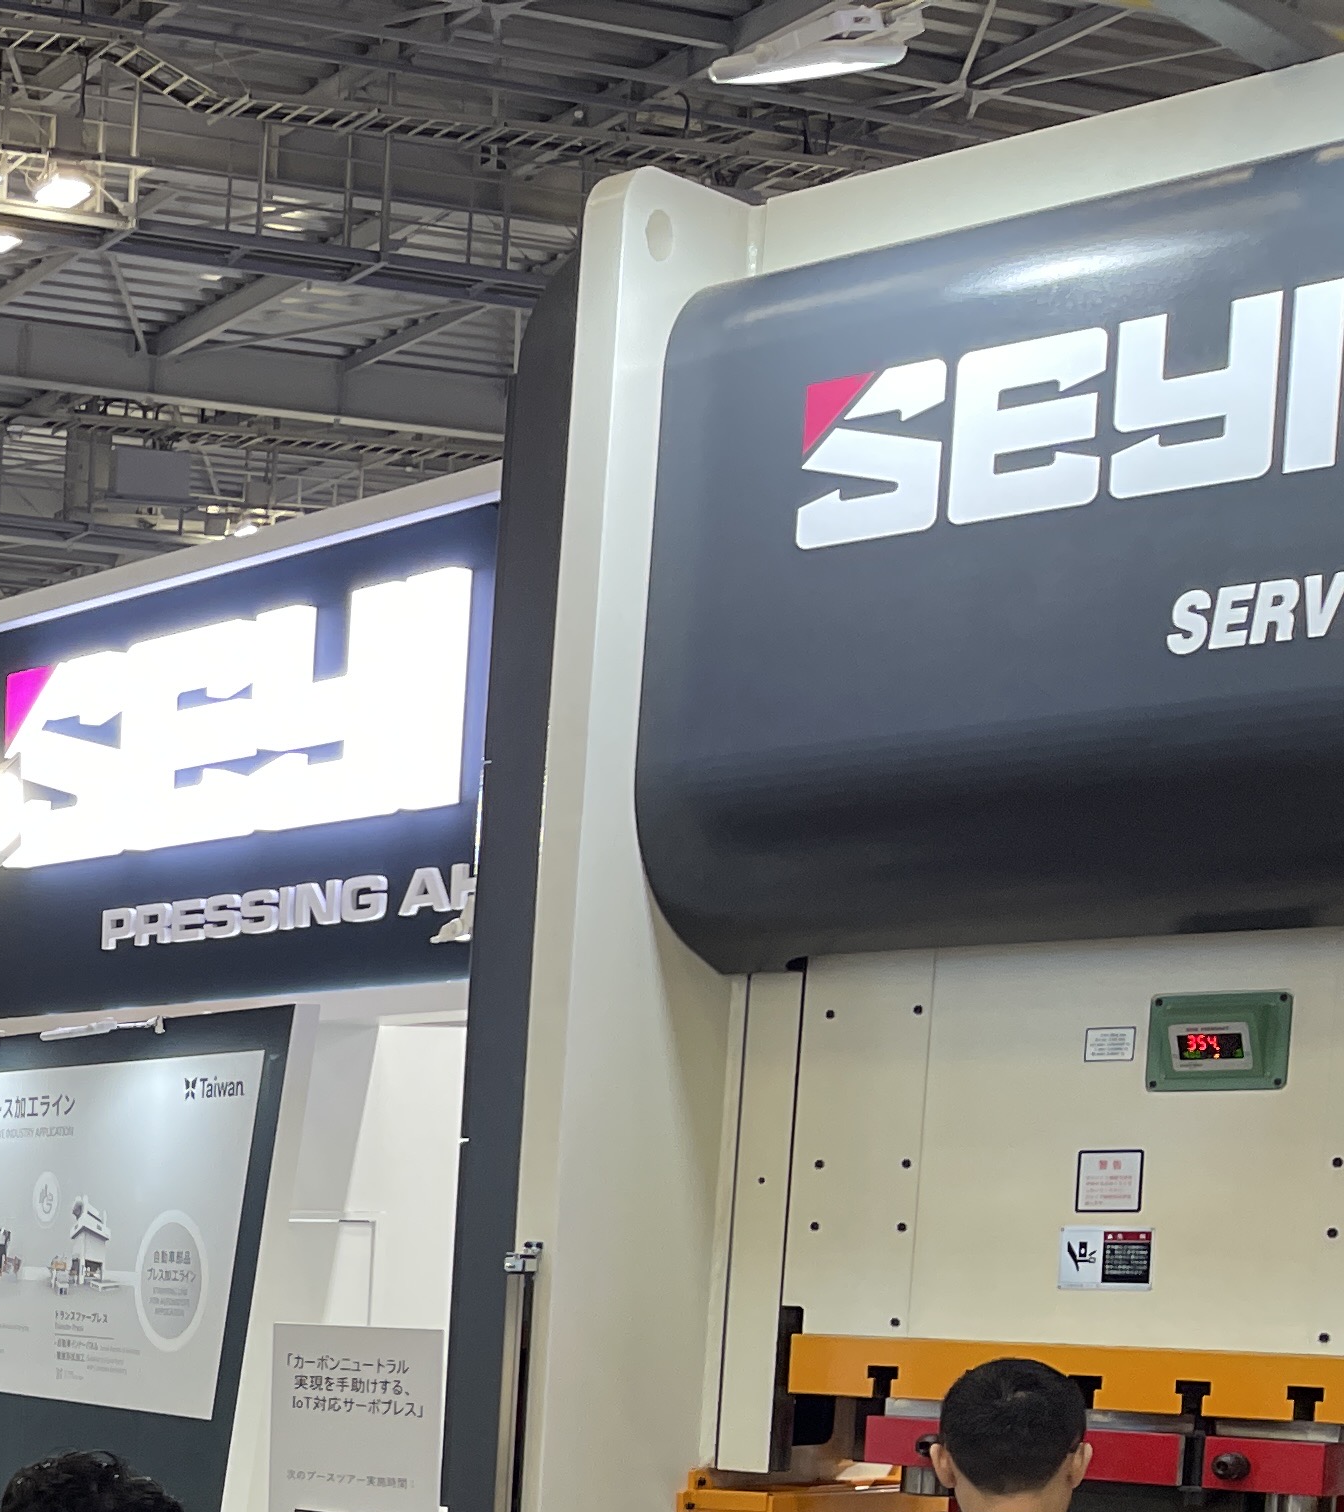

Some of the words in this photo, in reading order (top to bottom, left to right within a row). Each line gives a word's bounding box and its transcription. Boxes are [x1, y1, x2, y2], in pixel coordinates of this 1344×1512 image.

[1166, 571, 1344, 655] SERV
[101, 874, 388, 951] PRESSING
[200, 1077, 244, 1099] Taiwan
[55, 1310, 109, 1324] トランスファープレス
[286, 1352, 409, 1375] 「カーボンニュートラル
[294, 1375, 410, 1397] 実現を手助けする、
[292, 1395, 424, 1419] IoT対応サーボプレス」
